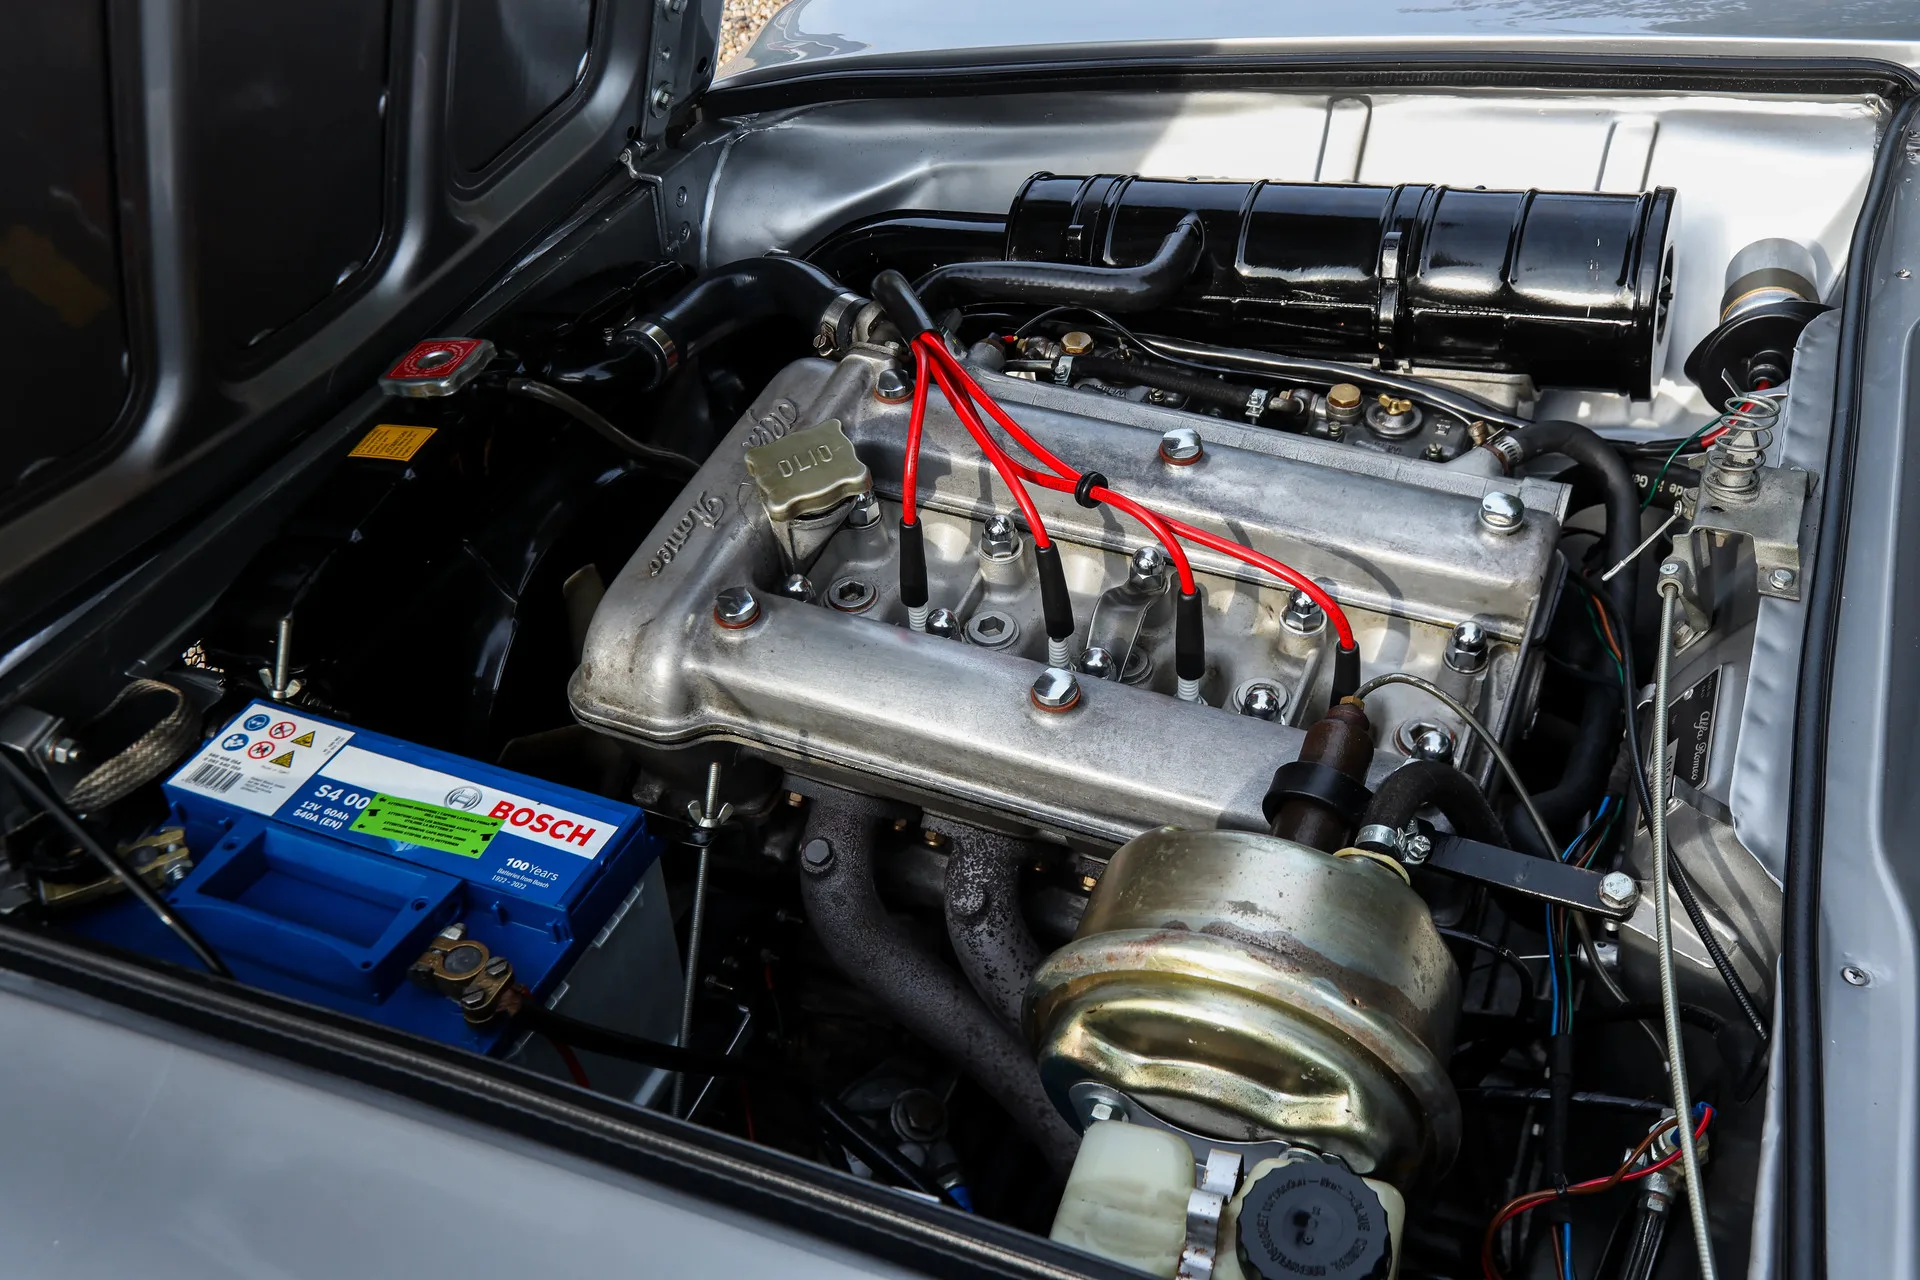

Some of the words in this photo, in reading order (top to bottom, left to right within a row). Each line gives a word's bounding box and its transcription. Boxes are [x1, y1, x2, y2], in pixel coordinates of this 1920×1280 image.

[776, 443, 834, 479] OLIO
[648, 490, 725, 577] Romeo
[1693, 710, 1710, 741] Alfa
[1691, 741, 1706, 781] Romeo
[314, 783, 345, 802] S4
[293, 808, 320, 823] 540A
[319, 816, 344, 831] (EN)
[300, 800, 323, 811] 12V
[323, 807, 350, 821] 60Ah
[487, 799, 597, 847] BOSCH
[496, 867, 521, 880] Batteries
[520, 874, 533, 884] from
[532, 879, 550, 889] Bosch
[506, 857, 530, 871] 100
[529, 864, 559, 881] Years
